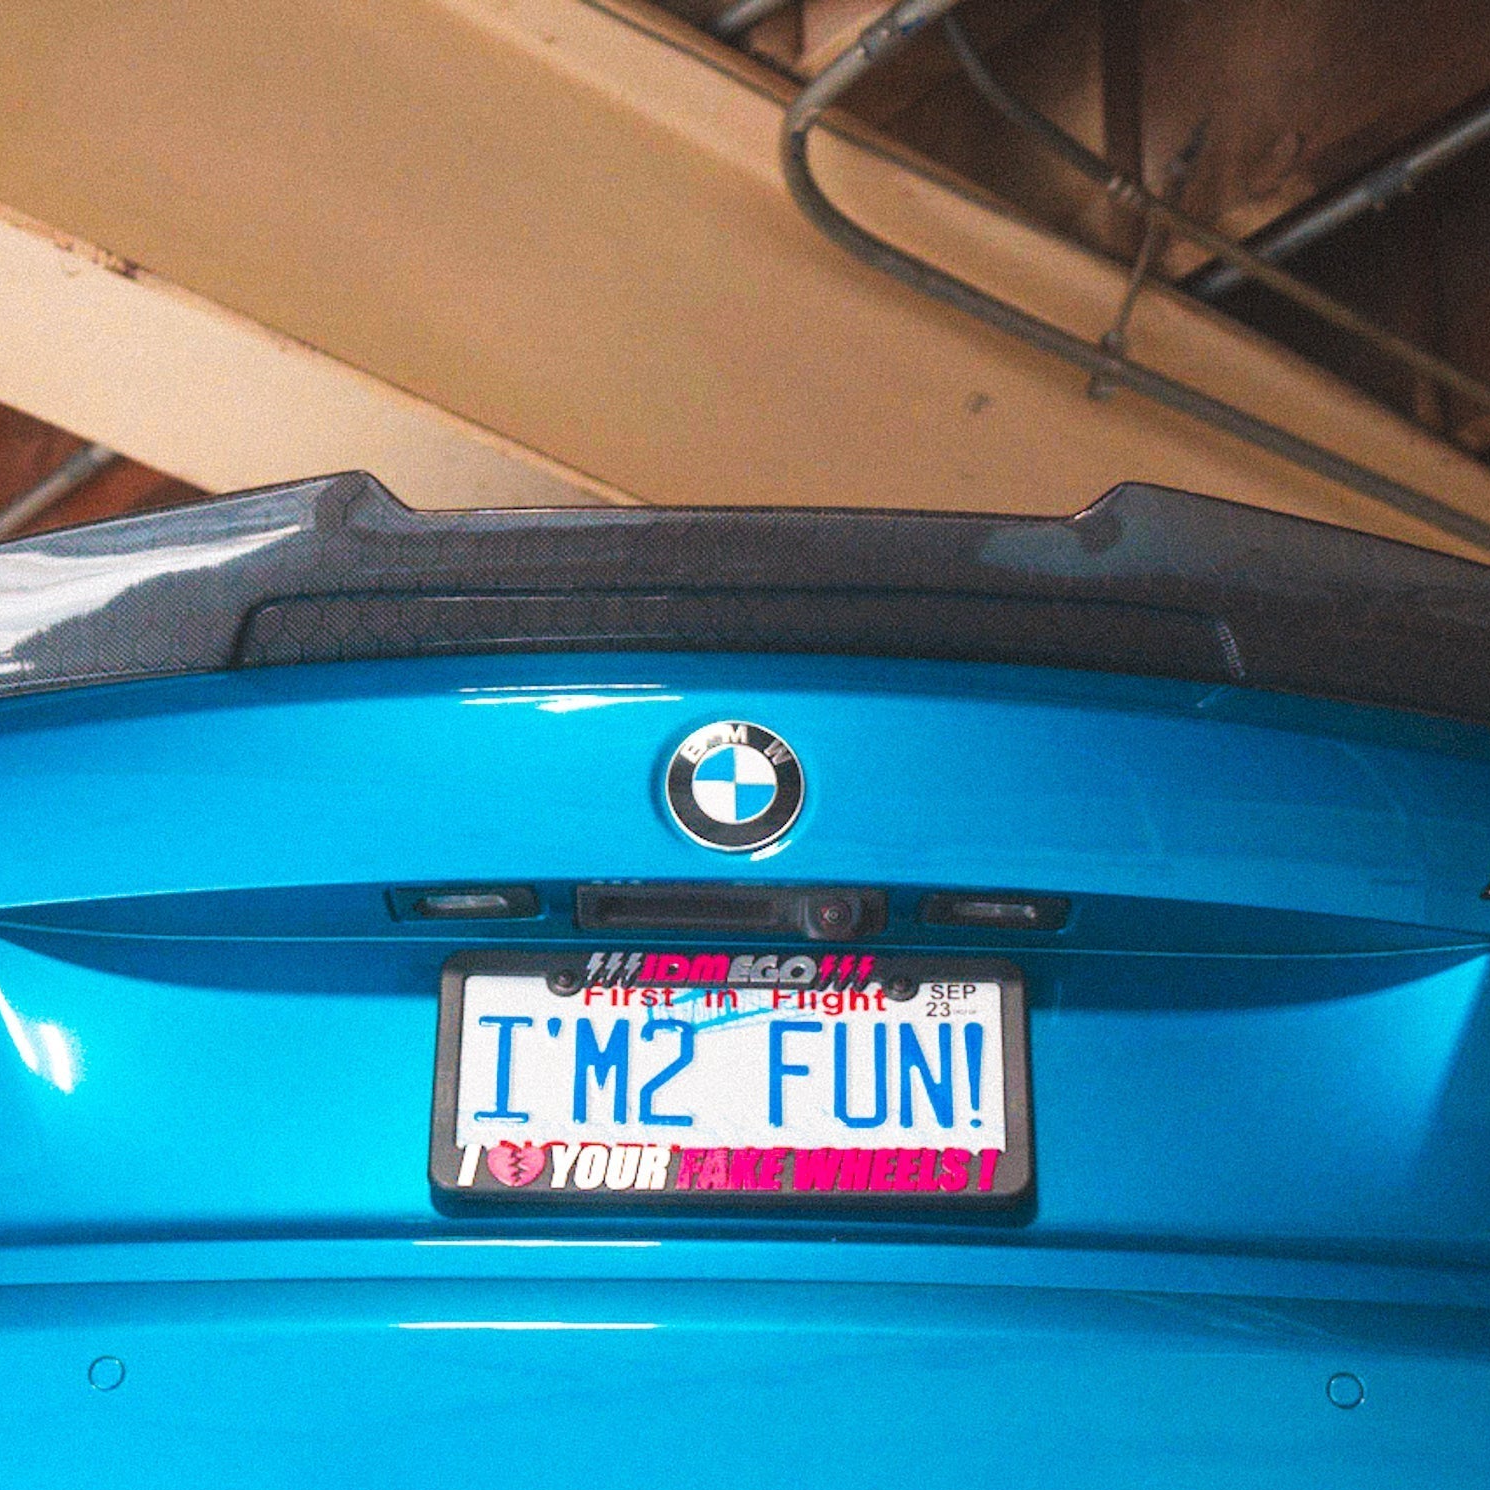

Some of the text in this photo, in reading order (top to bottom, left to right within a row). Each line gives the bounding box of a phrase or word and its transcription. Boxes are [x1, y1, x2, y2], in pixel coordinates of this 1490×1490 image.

[679, 724, 792, 765] BMW
[583, 982, 887, 1016] First in Flight
[926, 1002, 951, 1017] 23
[930, 984, 976, 999] SEP
[473, 1016, 984, 1129] I'M2 FUN!
[458, 1144, 483, 1187] I
[550, 1145, 669, 1190] YOUR
[675, 1148, 790, 1191] FAKE
